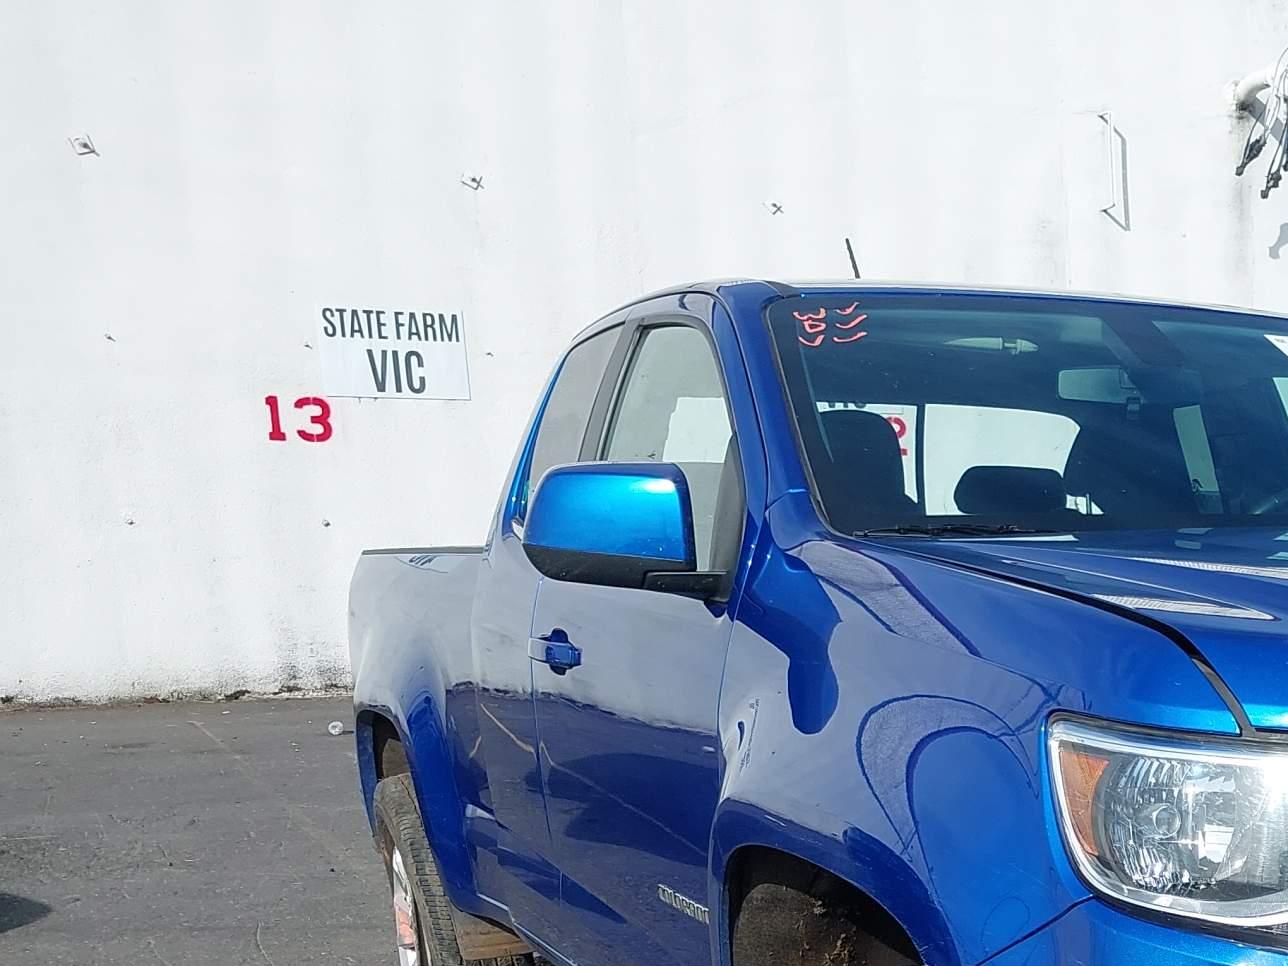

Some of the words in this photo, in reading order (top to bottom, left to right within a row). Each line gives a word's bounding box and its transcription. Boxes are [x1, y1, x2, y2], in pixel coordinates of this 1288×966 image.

[321, 307, 389, 340] STATE
[394, 311, 460, 342] FARM
[366, 348, 426, 394] VIC
[264, 395, 333, 442] 13
